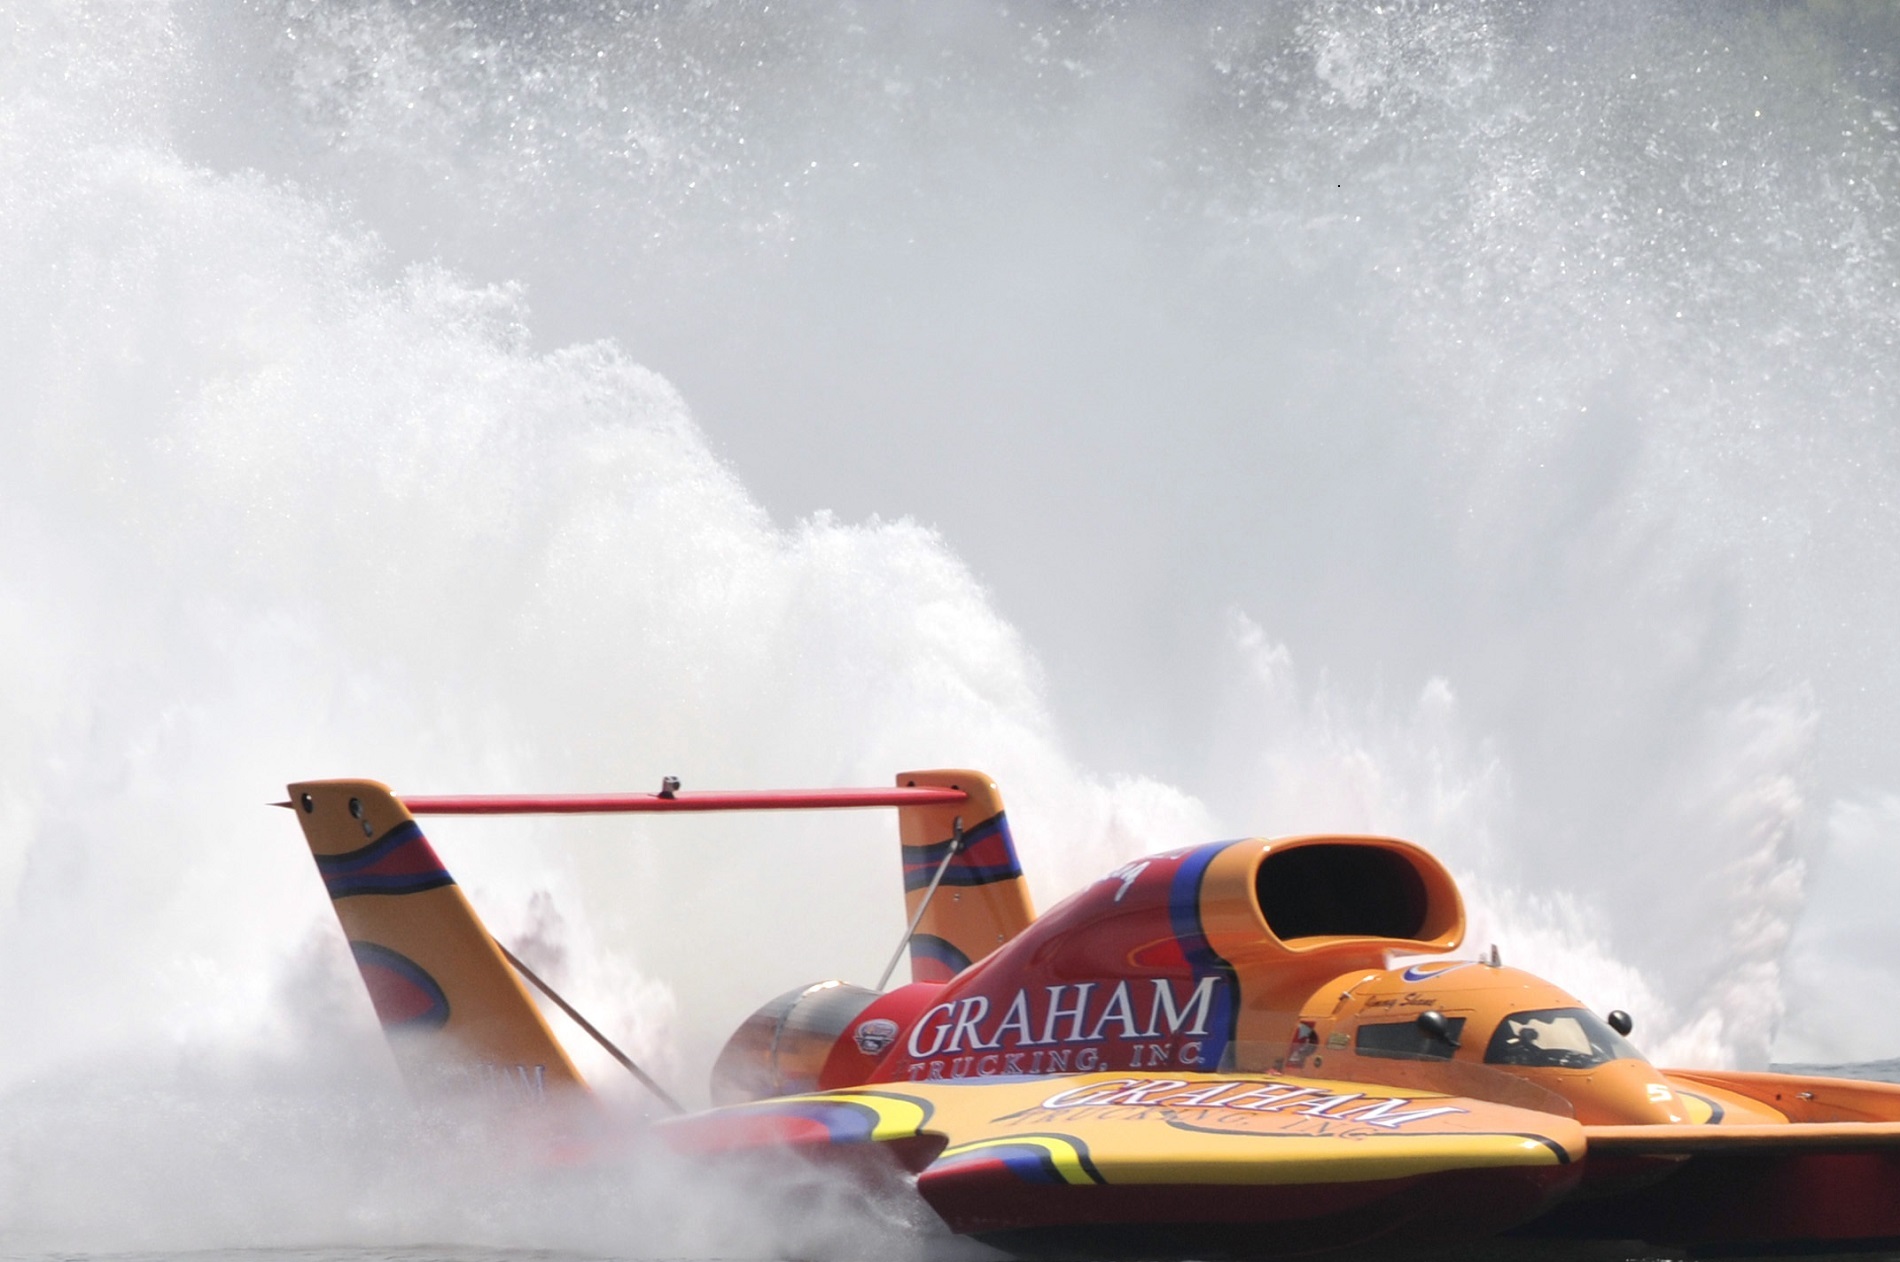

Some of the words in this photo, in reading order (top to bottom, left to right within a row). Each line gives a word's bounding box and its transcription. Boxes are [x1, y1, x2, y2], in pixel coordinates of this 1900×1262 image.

[907, 975, 1224, 1060] GRAHAM
[1040, 1078, 1470, 1129] GRAHAM
[1646, 1083, 1673, 1103] 5
